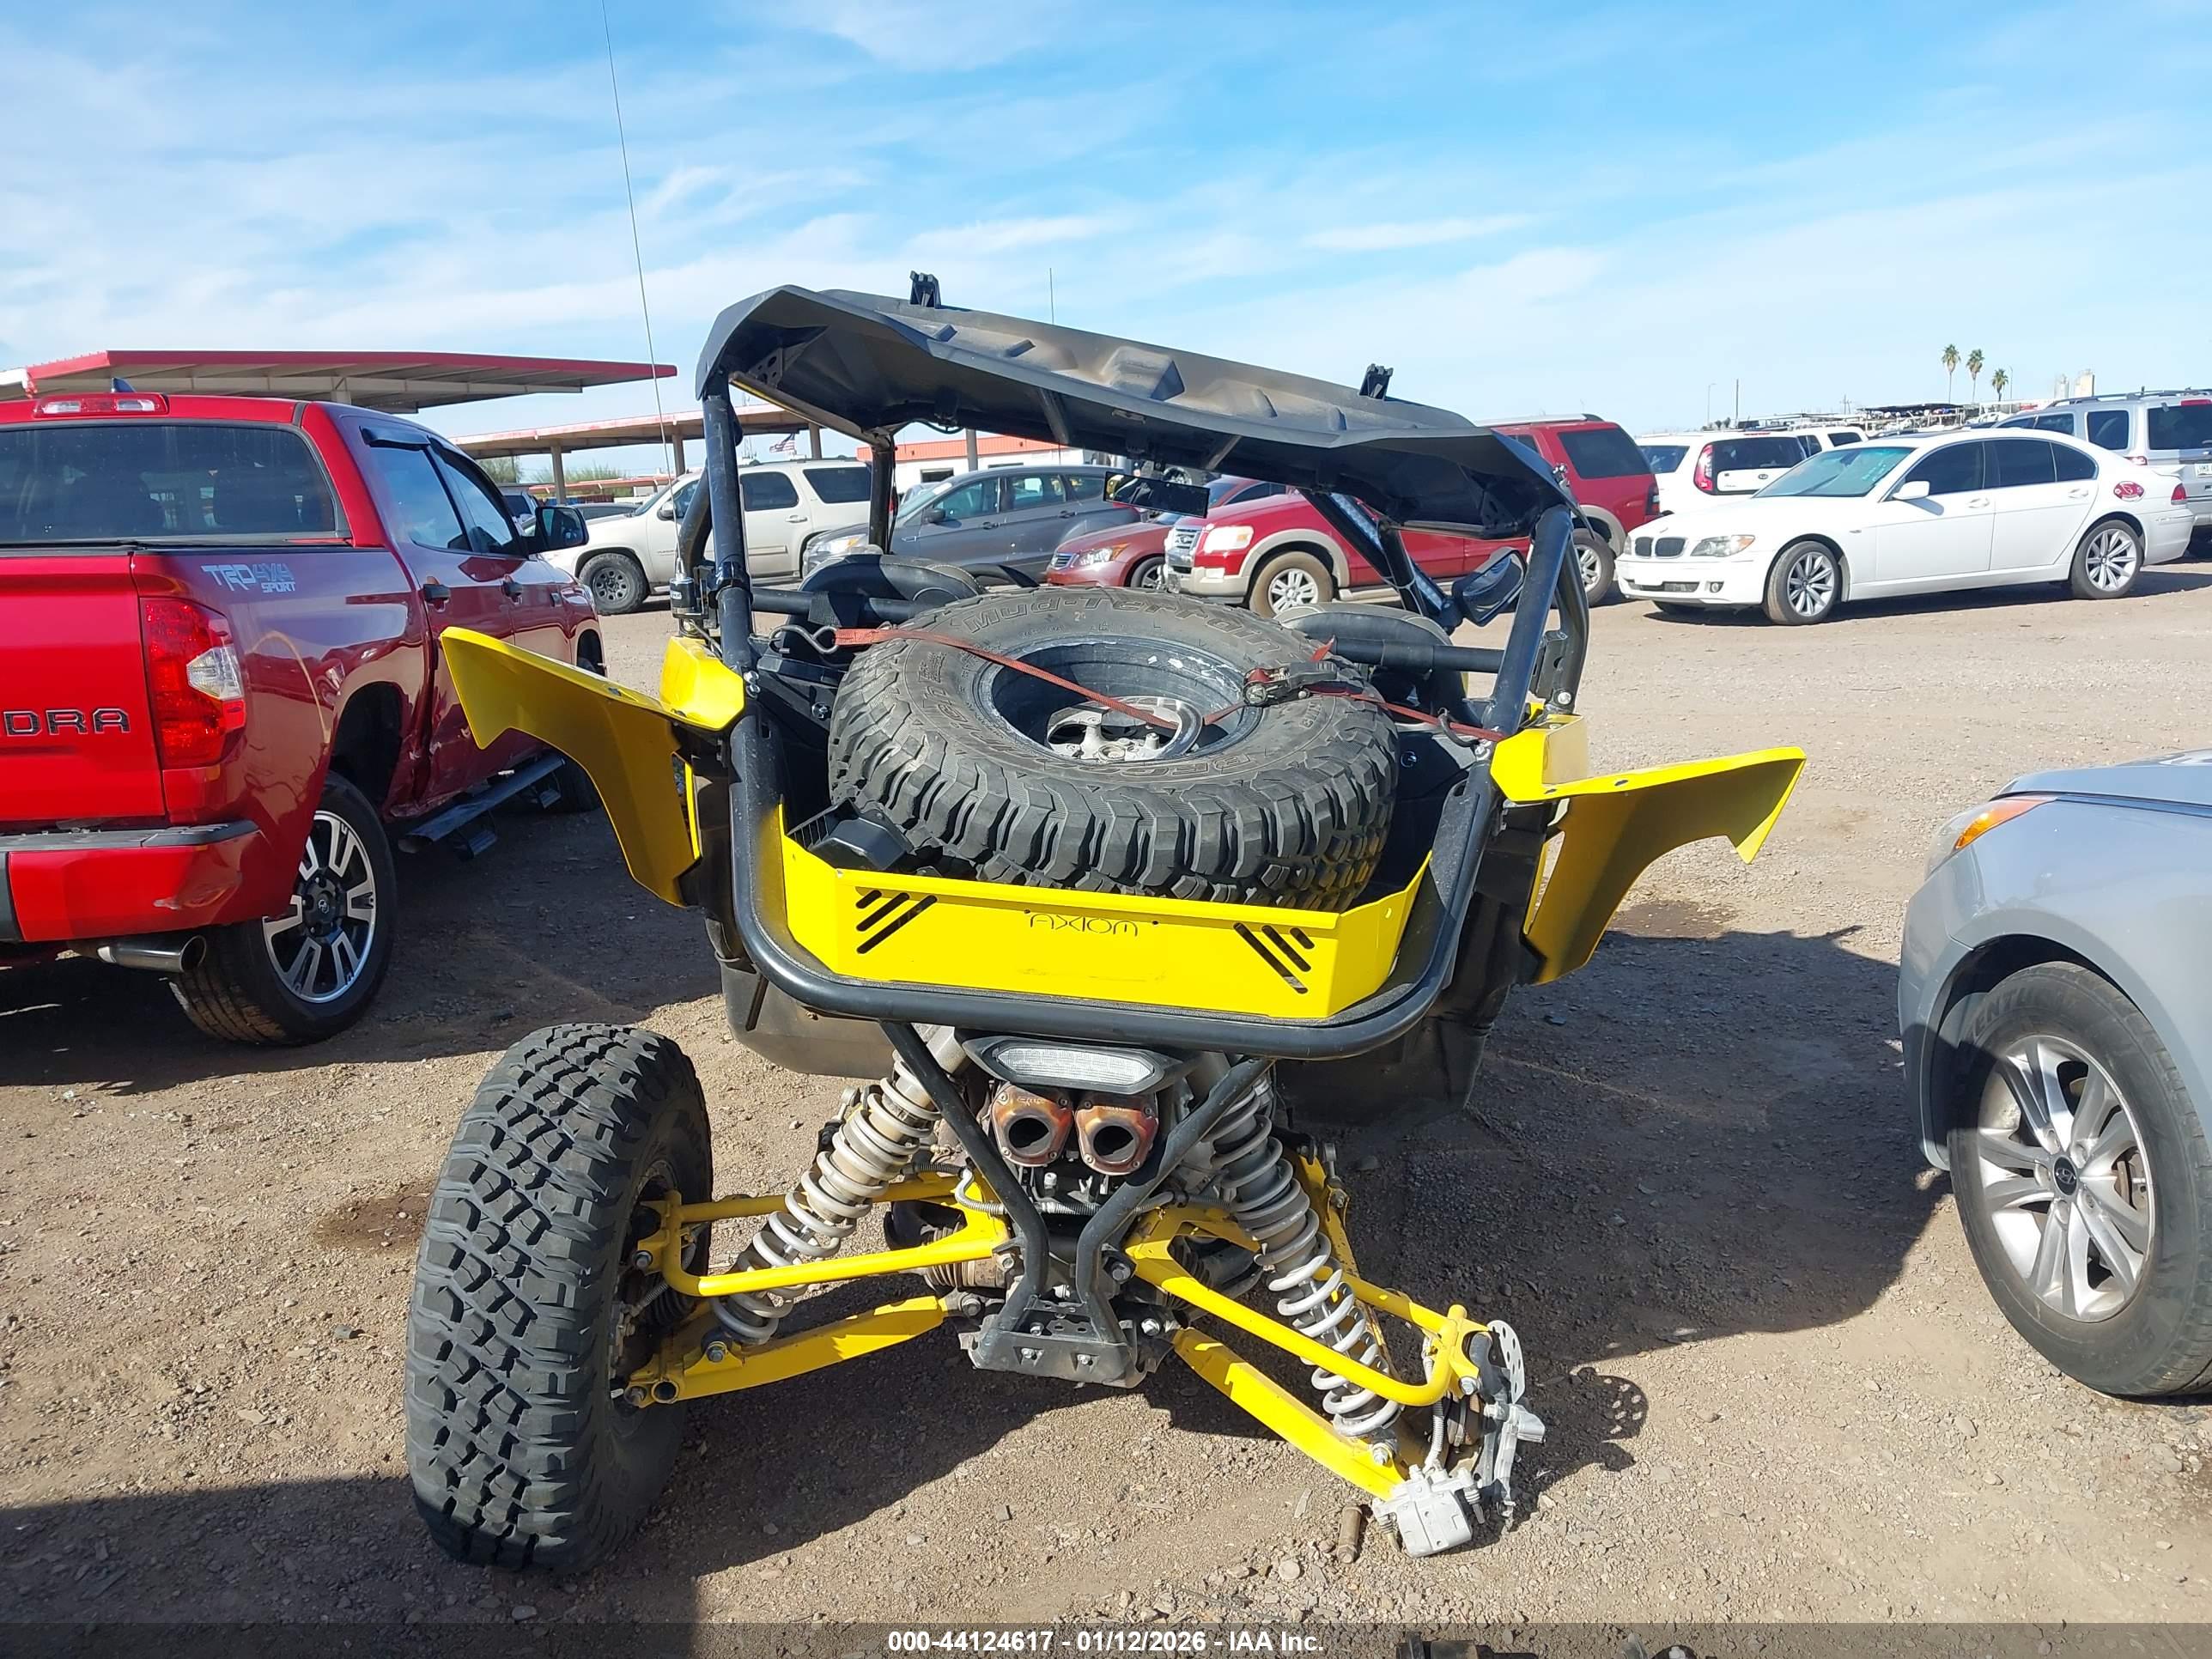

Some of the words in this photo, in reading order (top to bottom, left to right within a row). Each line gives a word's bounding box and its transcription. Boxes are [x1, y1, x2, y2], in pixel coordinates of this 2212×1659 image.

[200, 563, 256, 592] TRD
[260, 580, 295, 593] SPORT
[962, 596, 1281, 655] Mud-Terrain
[3, 708, 131, 737] DRA
[1030, 913, 1139, 937] AXIOM
